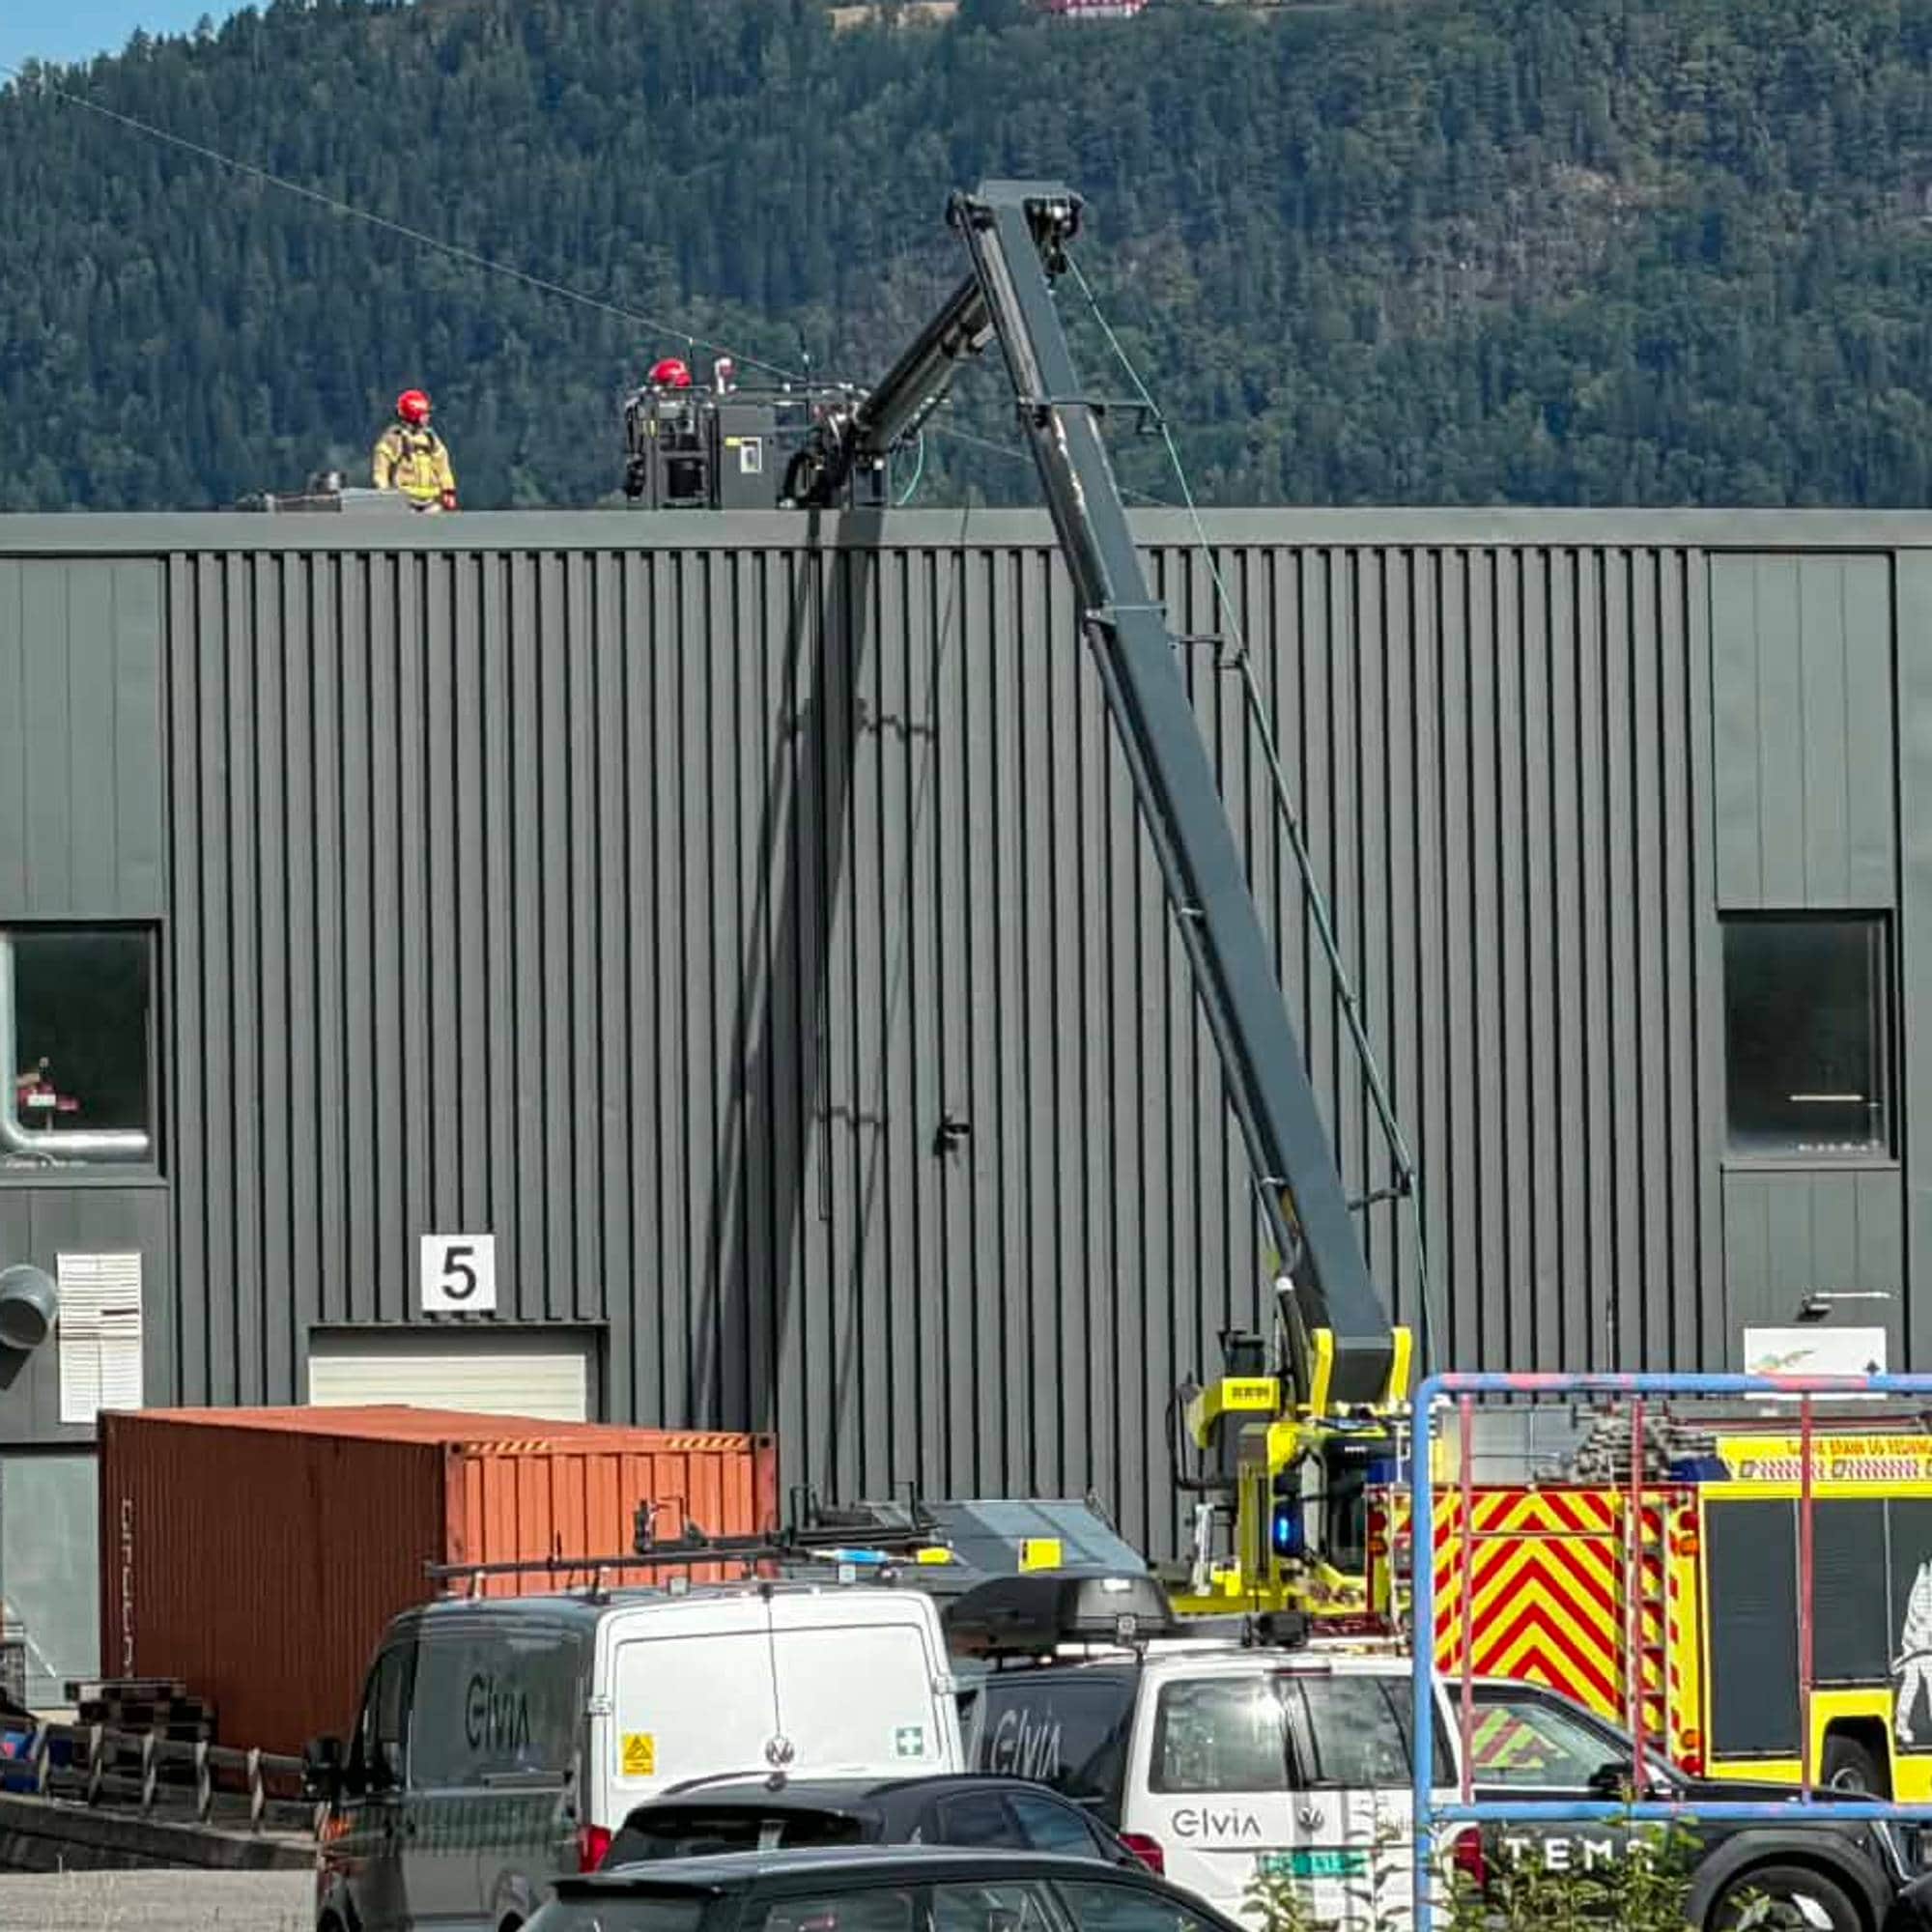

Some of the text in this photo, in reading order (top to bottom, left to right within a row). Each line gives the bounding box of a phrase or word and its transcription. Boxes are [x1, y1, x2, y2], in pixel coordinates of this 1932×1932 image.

[442, 1246, 477, 1301] 5
[465, 1673, 530, 1752] Elvia
[1172, 1807, 1262, 1836] Elvia
